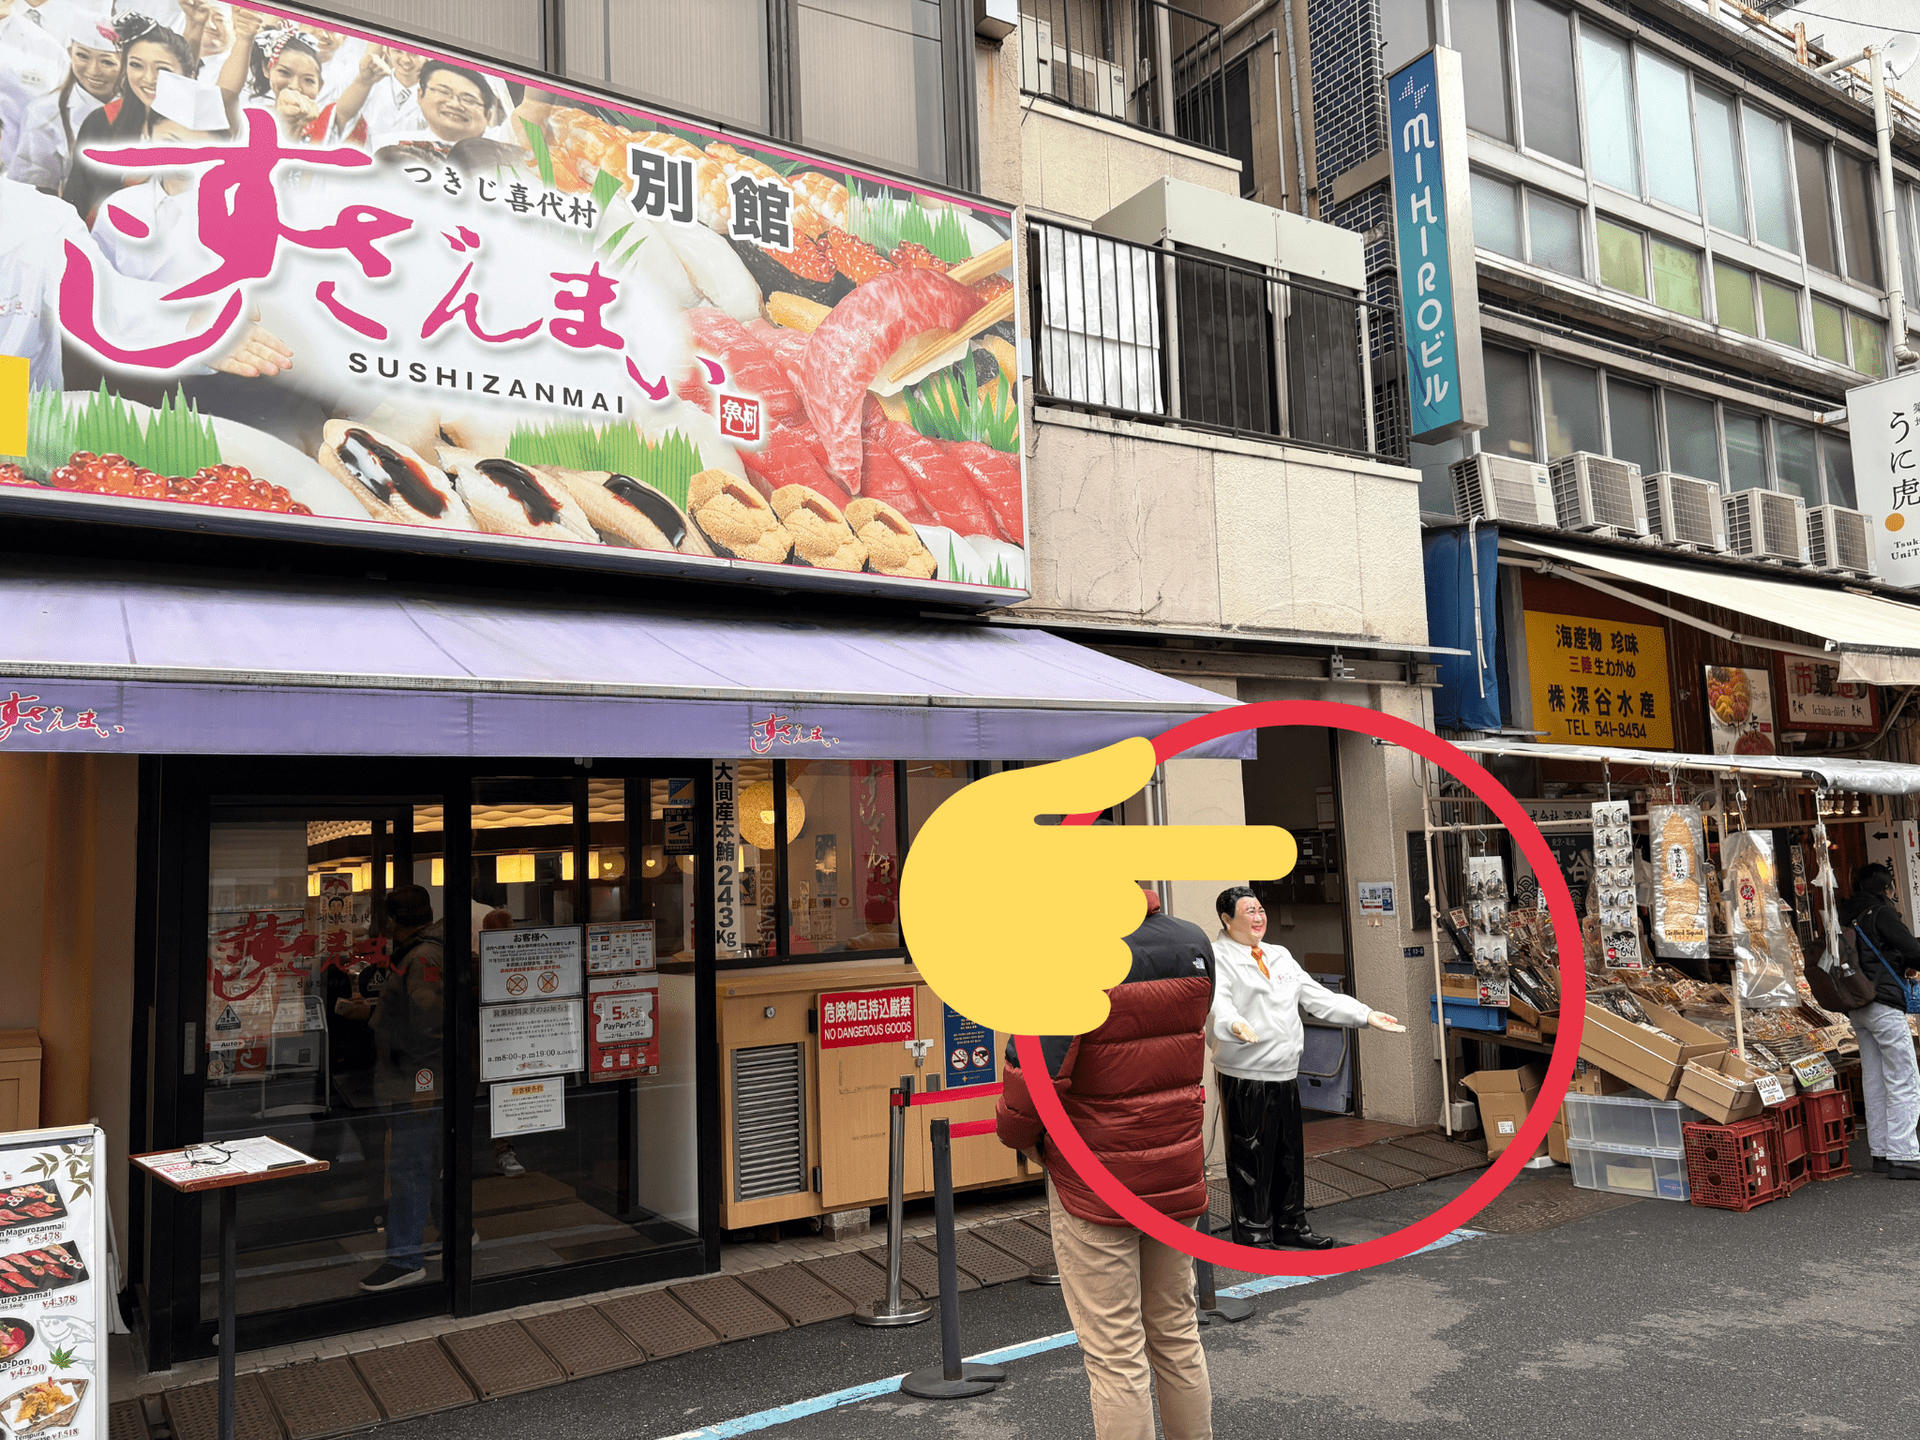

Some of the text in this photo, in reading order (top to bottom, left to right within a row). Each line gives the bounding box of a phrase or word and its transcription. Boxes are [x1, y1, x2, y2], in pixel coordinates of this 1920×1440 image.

[403, 163, 598, 229] つきじ喜代村
[631, 149, 790, 248] 別館
[1403, 112, 1449, 407] MIHIROビル
[348, 352, 626, 414] SUSHIZANMAI
[1890, 411, 1920, 510] うに虎
[1891, 548, 1920, 561] UniT
[1894, 538, 1920, 549] Tsuk
[1556, 624, 1639, 655] 海産物 珍味
[1565, 718, 1647, 739] TEL 541-8454
[824, 996, 911, 1024] 危険物品持込厳禁
[824, 1021, 912, 1040] NO DANGEROUS GOODS
[6, 1221, 64, 1237] Magurozanmai
[0, 1291, 51, 1305] urozanmai
